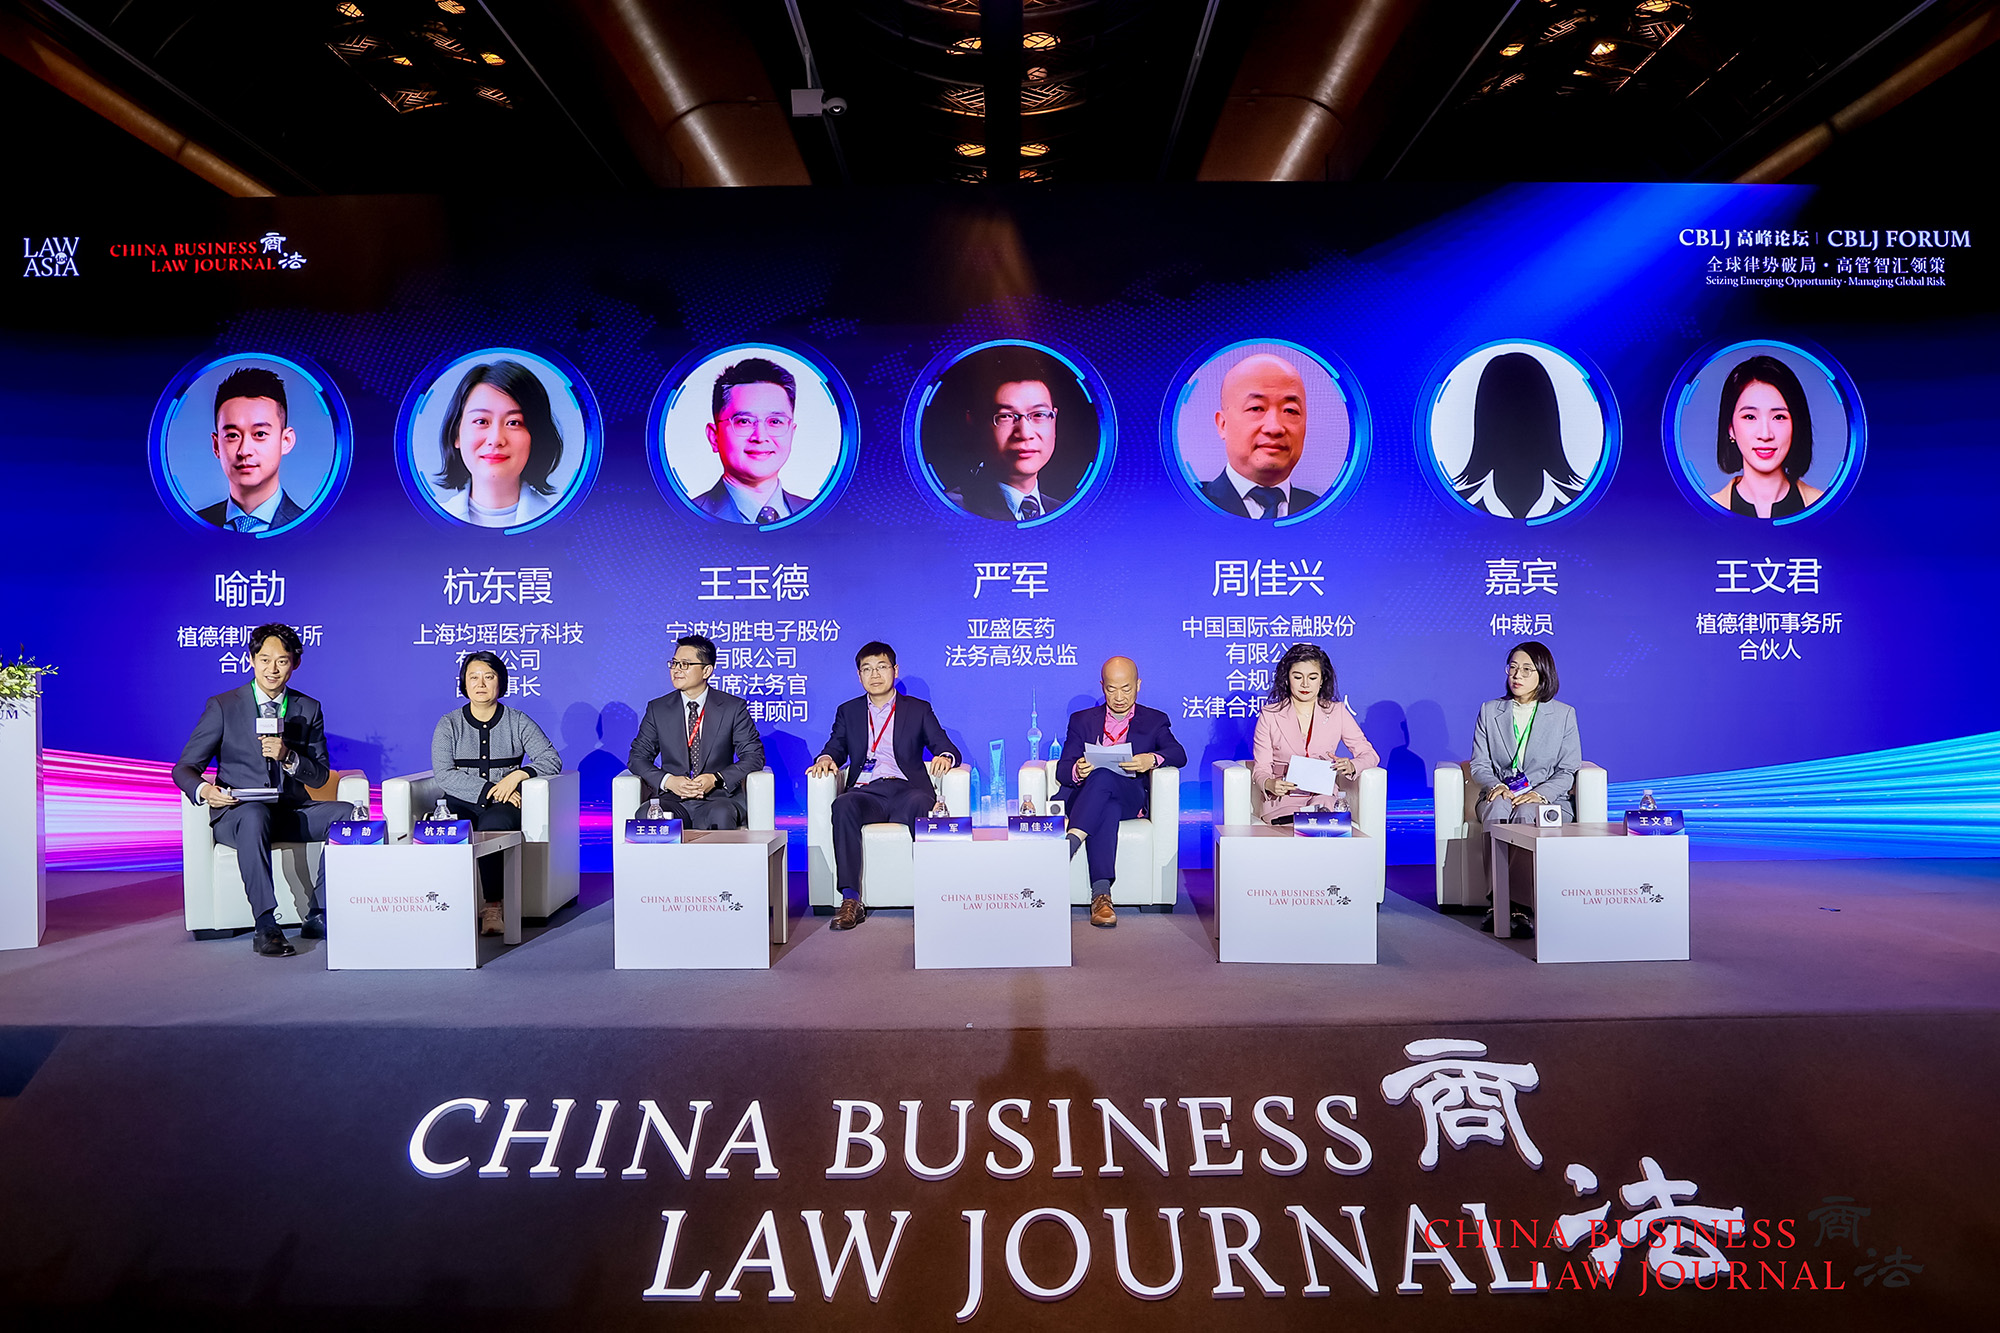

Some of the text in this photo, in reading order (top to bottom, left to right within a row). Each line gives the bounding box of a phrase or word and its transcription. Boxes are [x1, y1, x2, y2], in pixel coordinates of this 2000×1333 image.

[23, 236, 80, 258] LAW
[110, 241, 258, 257] CHINA BUSINESS
[1679, 229, 1971, 251] CBLJ 高峰论坛 CBLJ FORUM
[23, 257, 80, 277] ASIA
[151, 257, 276, 274] LAW JOURNAL
[1706, 275, 1946, 288] Seizing Emerging Opportunity Managing Global Risk
[443, 566, 554, 605] 杭东霞
[697, 563, 810, 602] 王玉德
[973, 562, 1049, 599] 严军
[1212, 558, 1325, 597] 周佳兴
[1485, 557, 1559, 596] 嘉宾
[1715, 556, 1823, 595] 王文君
[215, 569, 286, 608] 喻劼
[967, 617, 1056, 639] 亚盛医药
[1182, 615, 1356, 638] 中国国际金融股份
[1490, 613, 1555, 637] 仲裁员
[1696, 611, 1843, 635] 植德律师事务所
[413, 621, 584, 646] 上海均瑶医疗科技
[945, 643, 1078, 667] 法务高级总监
[1738, 638, 1802, 662] 合伙人
[424, 826, 458, 837] 杭东霞
[635, 825, 670, 836] 王玉德
[928, 823, 959, 833] 严军
[1019, 822, 1054, 833] 周佳兴
[1639, 816, 1674, 827] 王文君
[350, 895, 425, 904] CHINA BUSINESS
[640, 895, 718, 904] CHINA BUSINESS
[941, 893, 1019, 902] CHINA BUSINESS
[1247, 889, 1326, 897] CHINA BUSINESS
[1269, 898, 1335, 907] LAW JOURNAL
[1561, 888, 1639, 897] CHINA BUSINESS
[1583, 896, 1649, 906] LAW JOURNAL
[370, 904, 435, 914] LAW JOURNAL
[662, 904, 728, 913] LAW JOURNAL
[963, 901, 1029, 911] LAW JOURNAL
[407, 1094, 1374, 1181] CHINA BUSINESS
[642, 1202, 1549, 1325] LAW JOURNAL
